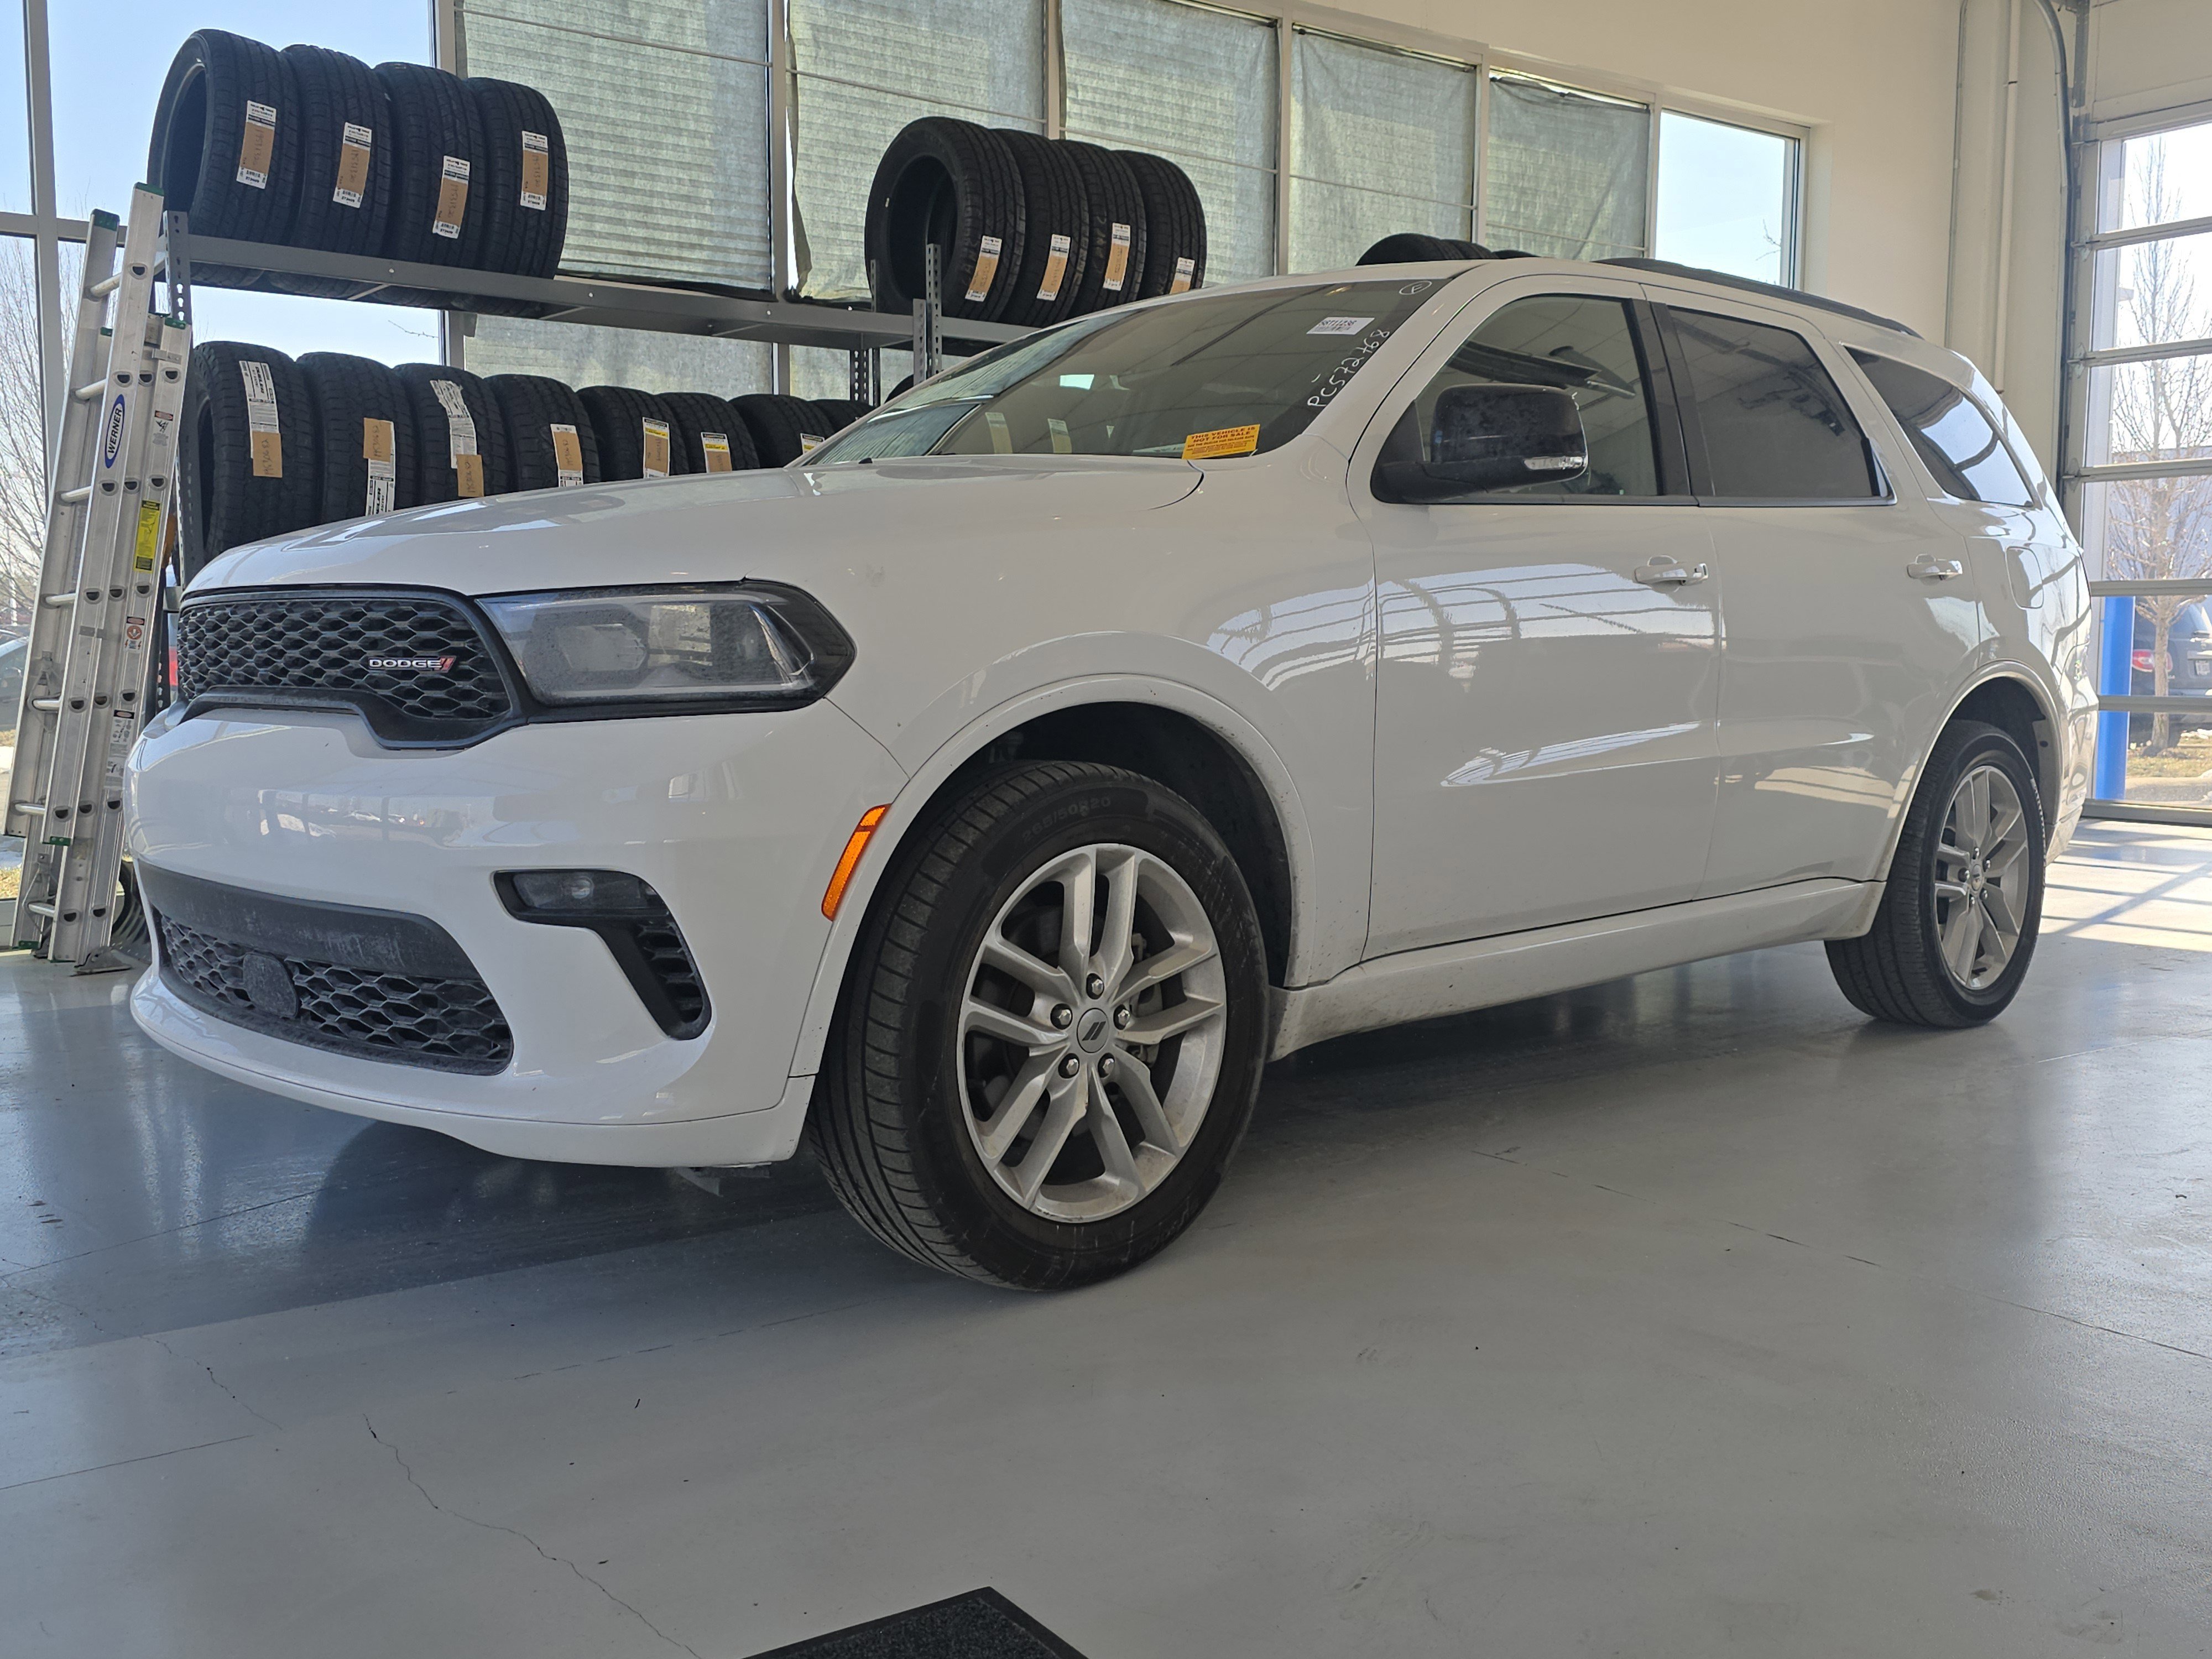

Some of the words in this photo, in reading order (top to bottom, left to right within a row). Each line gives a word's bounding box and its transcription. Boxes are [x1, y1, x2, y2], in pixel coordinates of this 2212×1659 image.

[108, 408, 122, 454] WERNER
[1212, 427, 1245, 436] VEHICLE
[369, 659, 442, 668] DODGE
